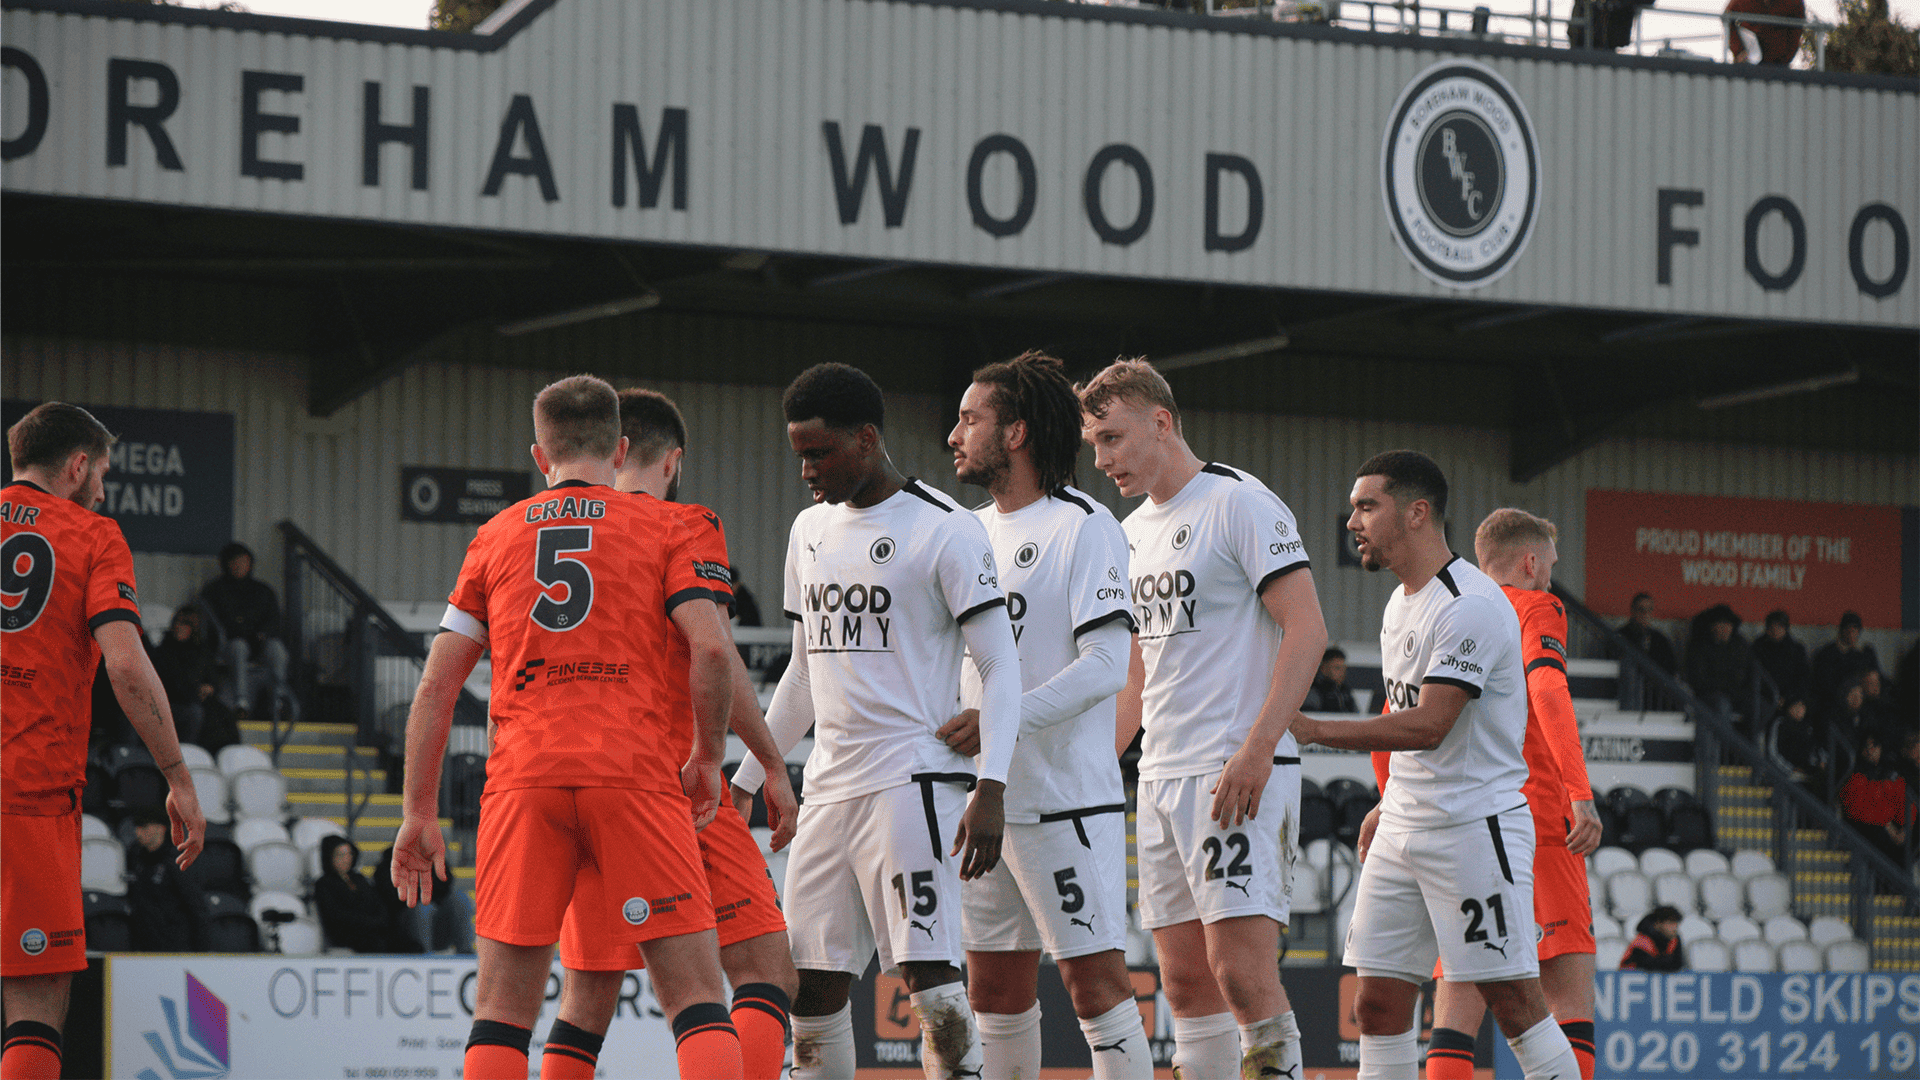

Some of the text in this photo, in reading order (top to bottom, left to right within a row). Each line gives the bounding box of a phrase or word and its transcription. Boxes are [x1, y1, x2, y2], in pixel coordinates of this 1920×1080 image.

[1473, 91, 1512, 135] WOOD
[821, 120, 1265, 254] WOOD
[1656, 186, 1911, 303] FOO
[103, 480, 184, 517] TAND
[525, 496, 606, 524] CRAIG
[1636, 527, 1851, 564] PROUD MEMBER OF THE
[530, 525, 595, 632] 5
[1681, 559, 1807, 590] WOOD FAMILY
[804, 583, 892, 614] WOOD
[808, 615, 890, 648] ARMY
[547, 661, 630, 679] FINESSE
[1440, 654, 1484, 676] Citygate
[1202, 832, 1253, 883] 22
[891, 870, 938, 919] 15
[1053, 866, 1086, 914] 5
[1460, 893, 1508, 944] 21
[1779, 974, 1920, 1024] SKIPS
[1604, 1030, 1917, 1073] 020 3124 19
